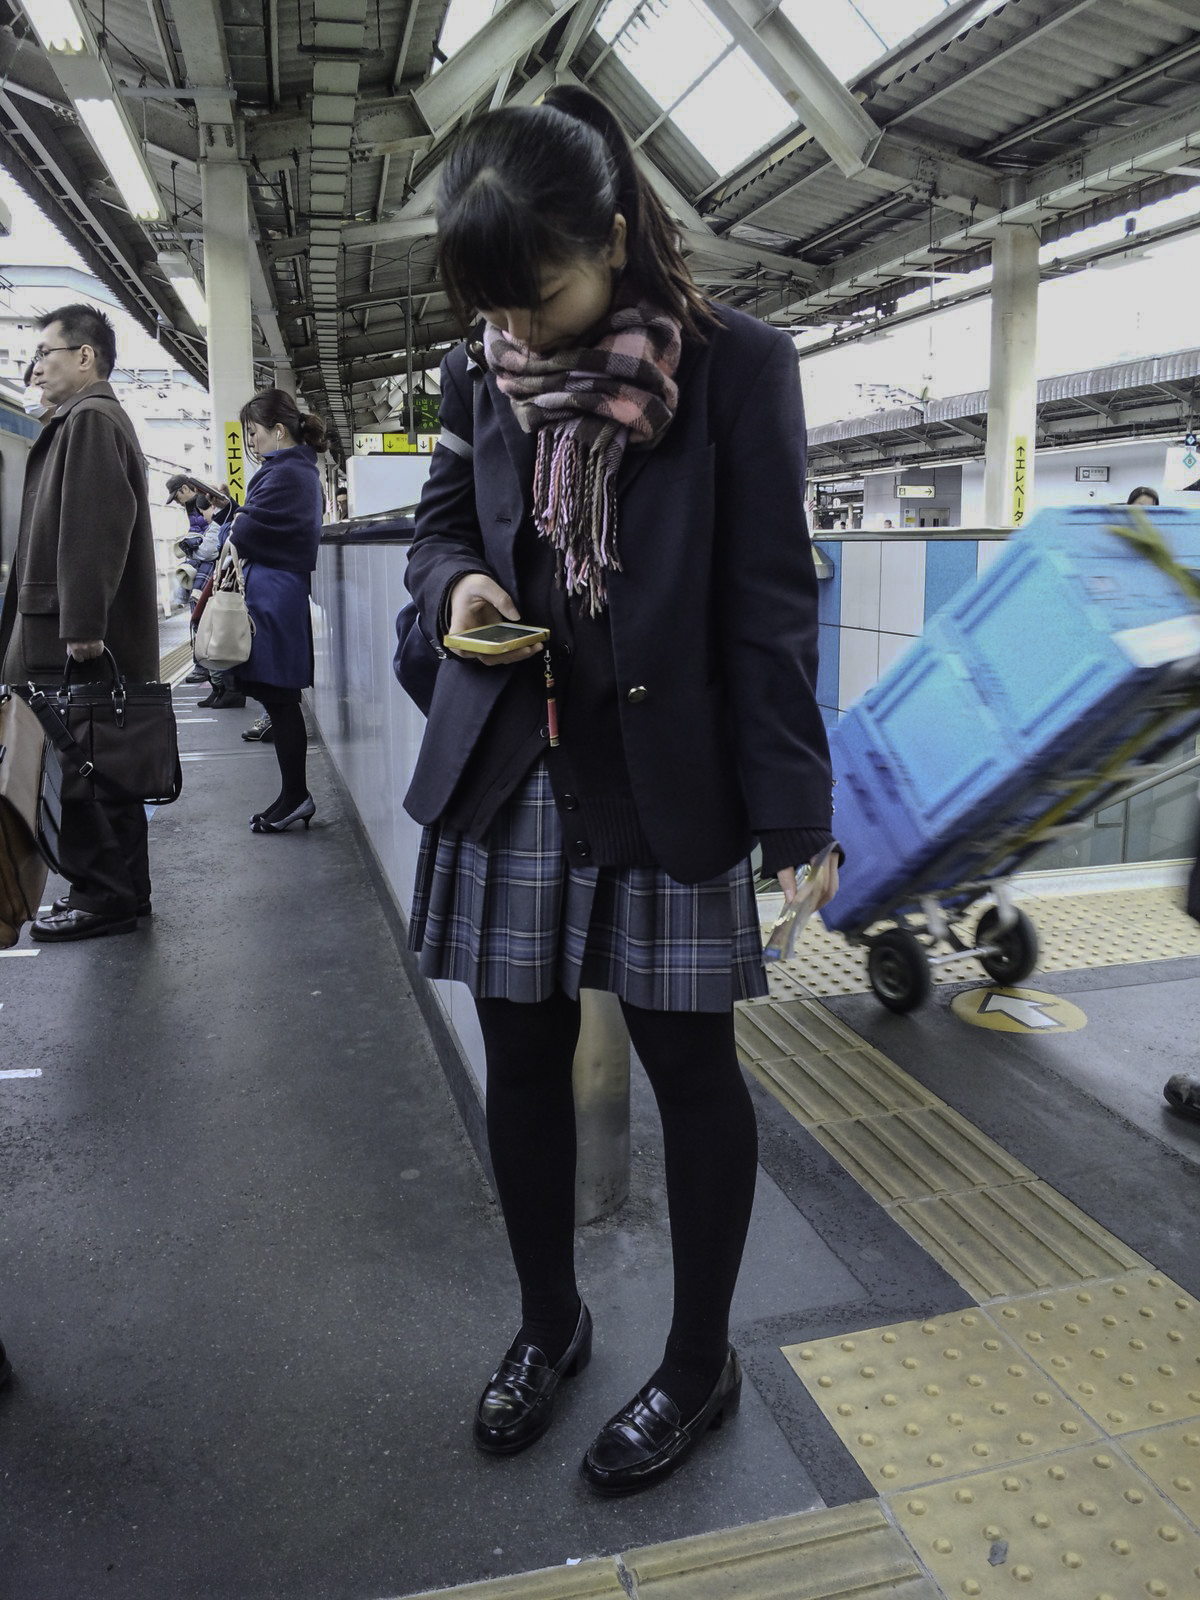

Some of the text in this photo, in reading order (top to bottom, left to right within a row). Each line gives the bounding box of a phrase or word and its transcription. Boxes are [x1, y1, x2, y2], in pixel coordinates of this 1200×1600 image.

[1014, 459, 1025, 526] エレベータ
